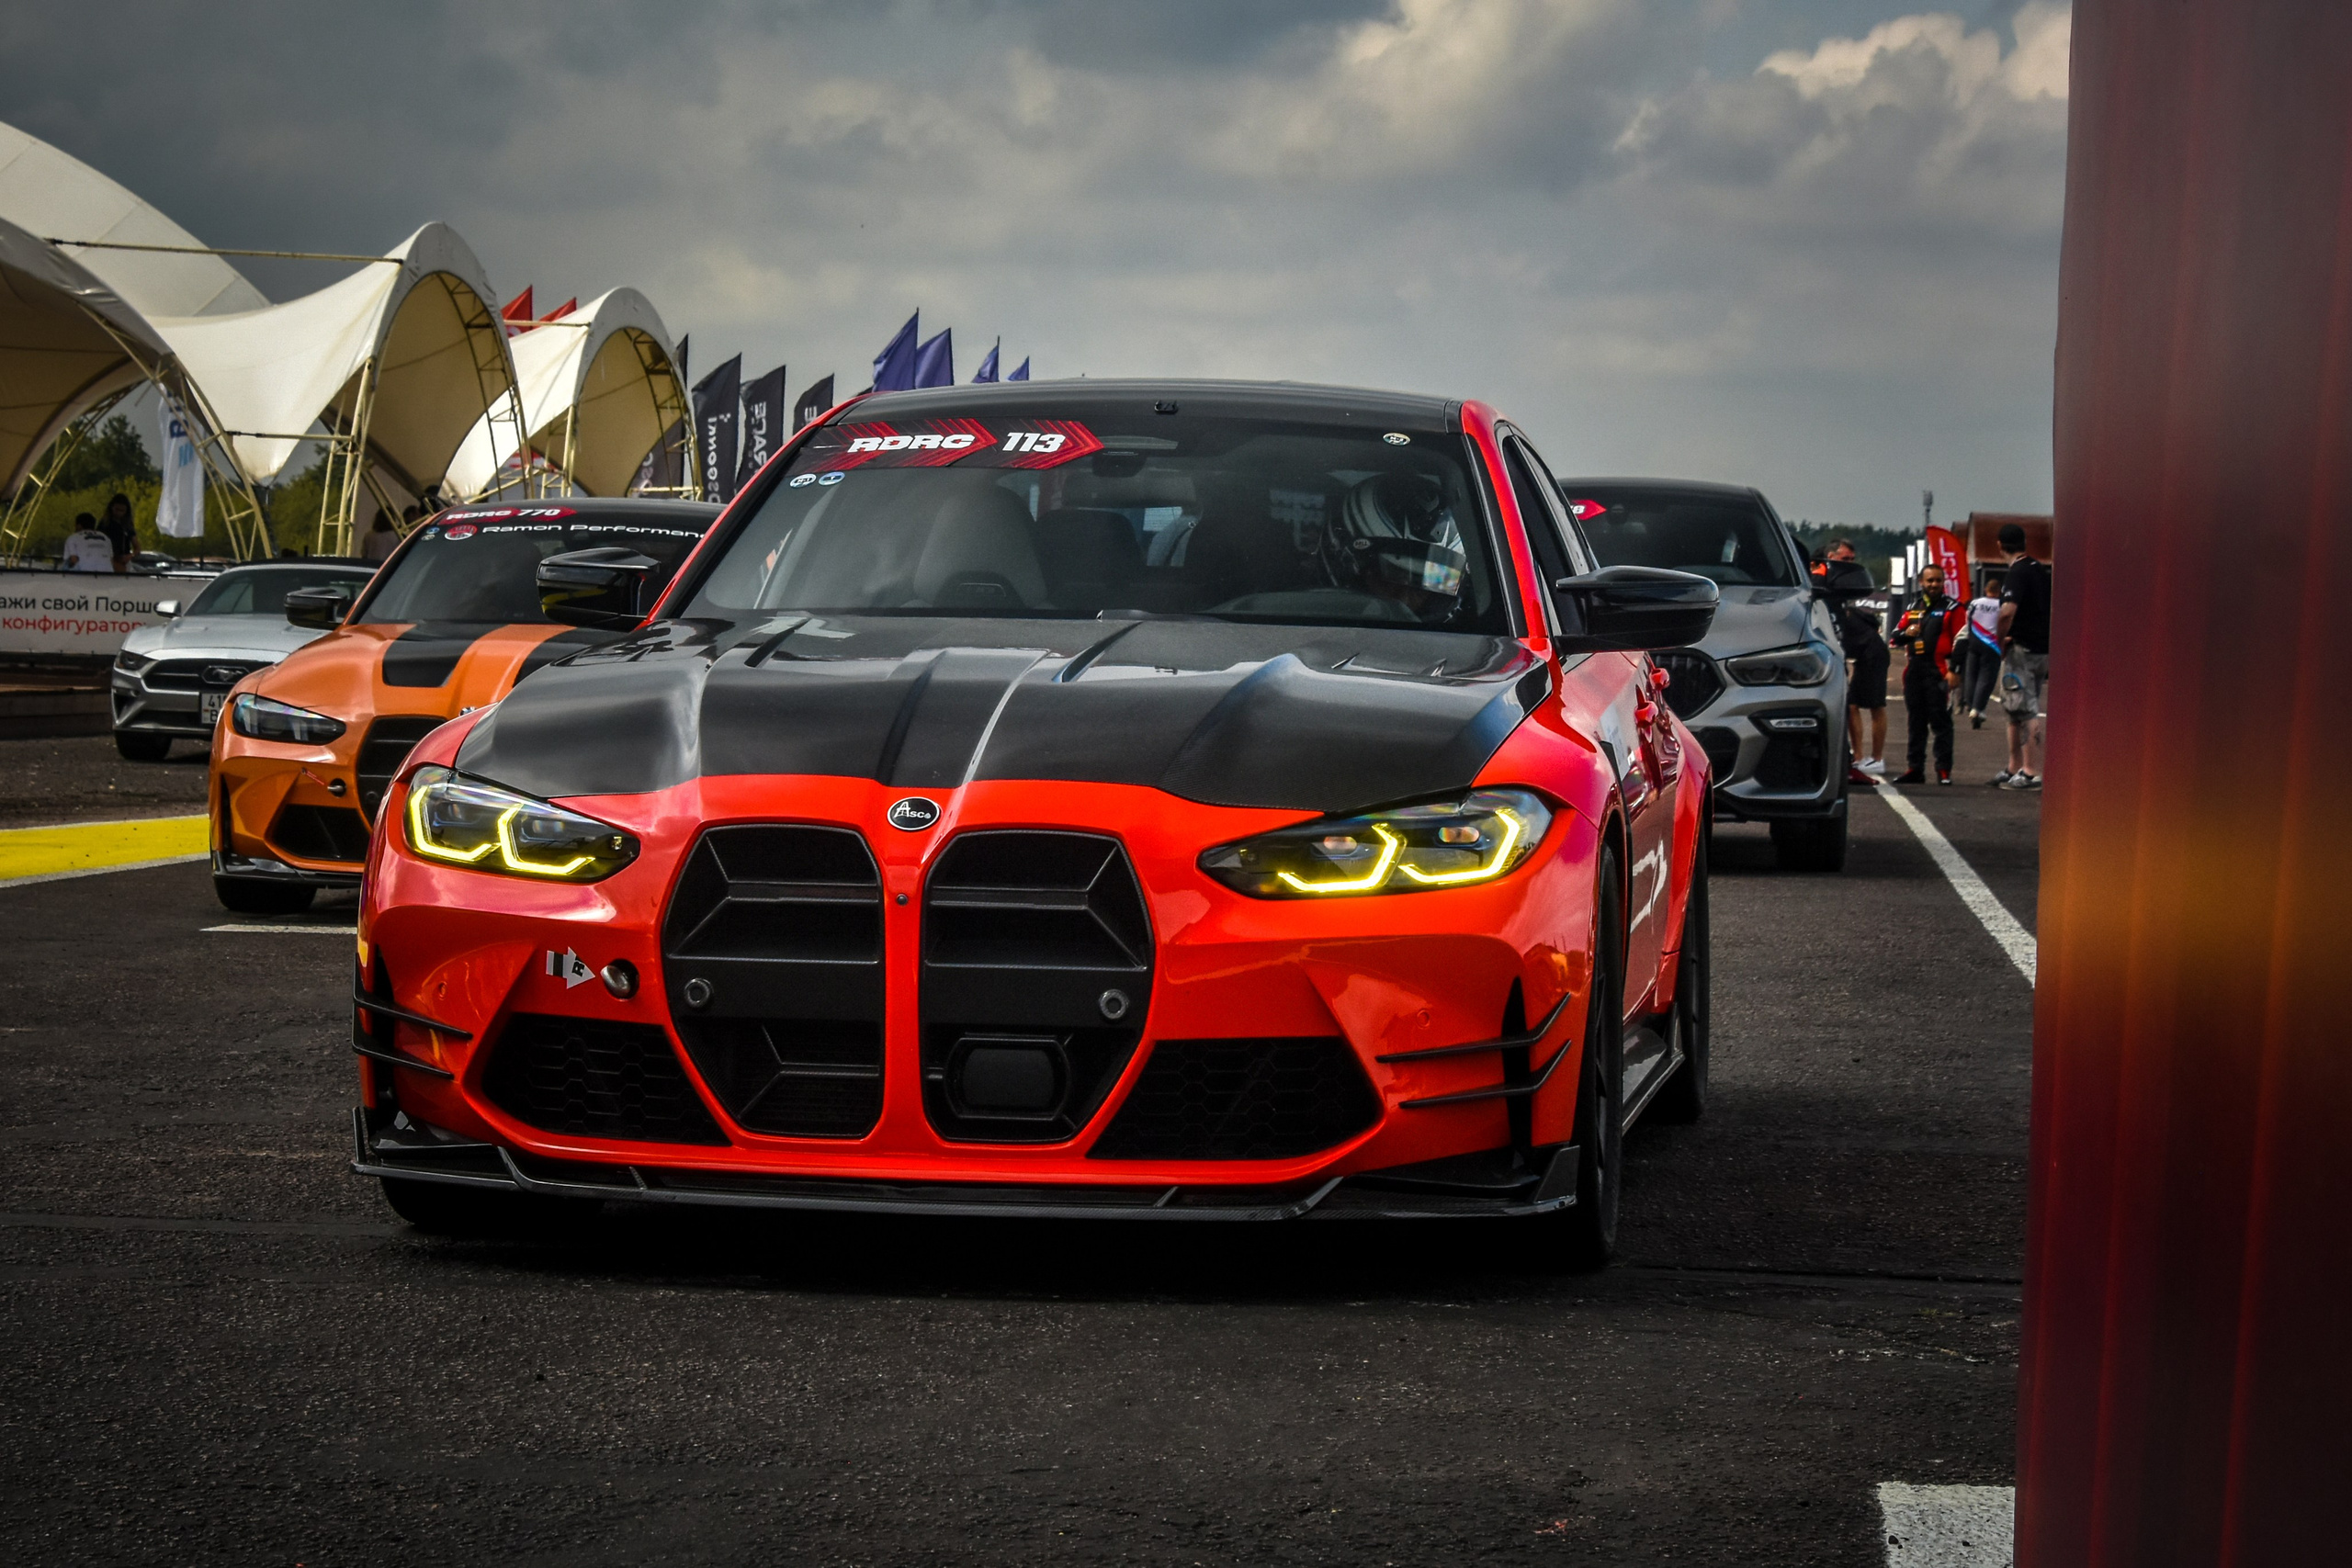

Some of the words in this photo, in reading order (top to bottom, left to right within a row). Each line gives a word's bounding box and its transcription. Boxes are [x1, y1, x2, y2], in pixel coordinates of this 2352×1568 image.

[847, 434, 976, 453] RDRC
[1002, 433, 1067, 453] 113
[482, 525, 562, 533] Ramon
[41, 595, 89, 612] свой
[2, 615, 147, 636] конфигурато
